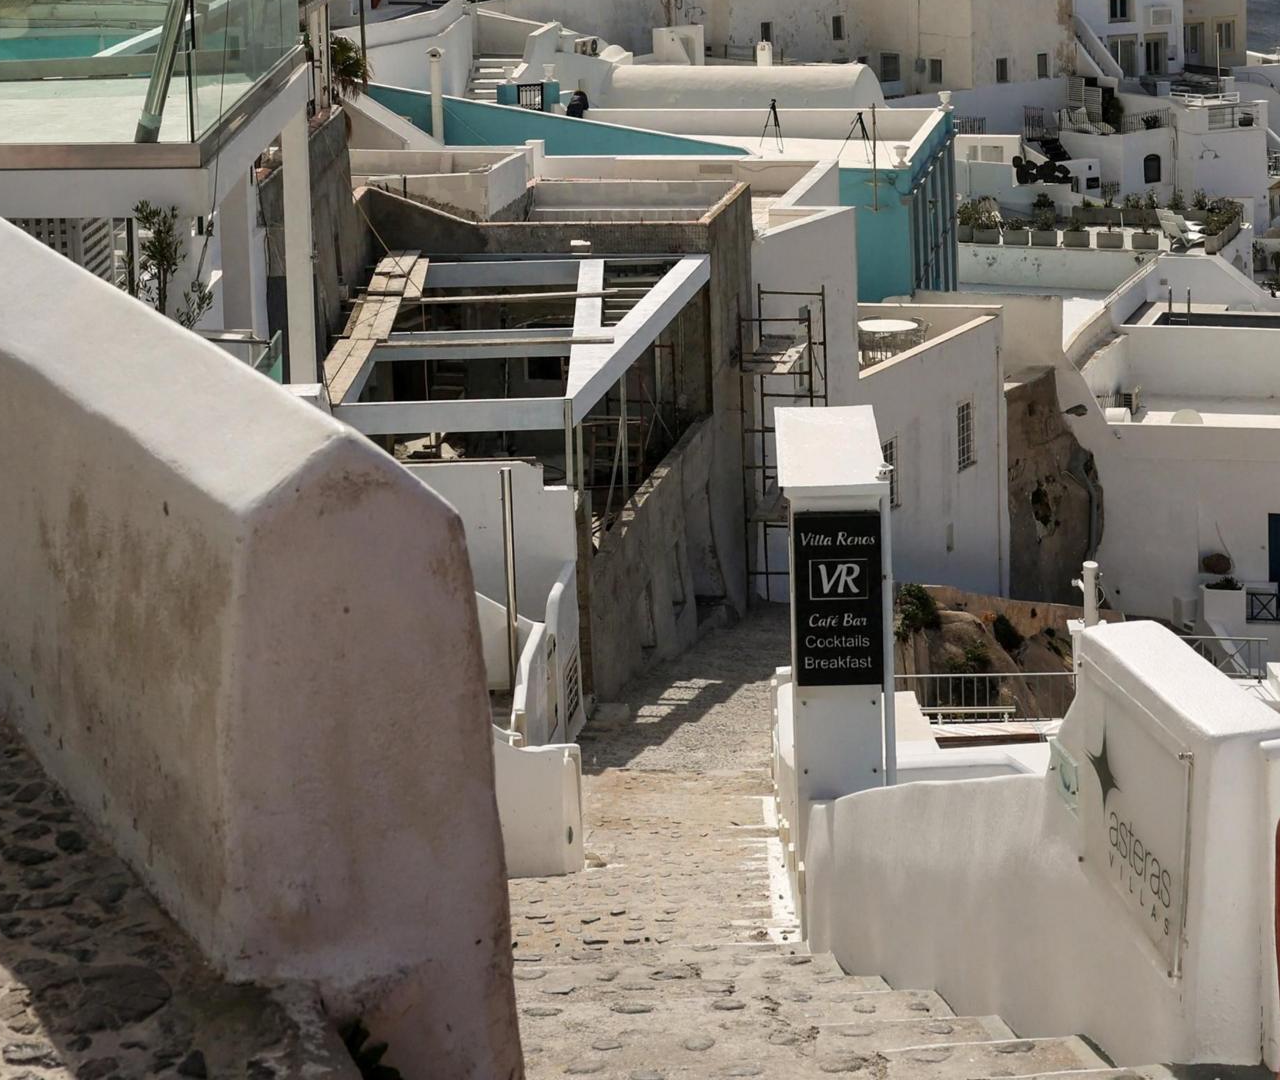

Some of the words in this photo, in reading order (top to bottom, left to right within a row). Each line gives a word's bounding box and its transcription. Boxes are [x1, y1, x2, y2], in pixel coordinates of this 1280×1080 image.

[800, 532, 832, 546] Villa
[837, 531, 876, 546] Renos
[818, 563, 861, 594] VR
[808, 613, 839, 628] Café
[843, 612, 867, 627] Bar
[805, 635, 870, 649] Cocktails
[804, 655, 872, 670] Breakfast
[1108, 810, 1172, 909] asteras
[1108, 849, 1170, 936] VILLAS
